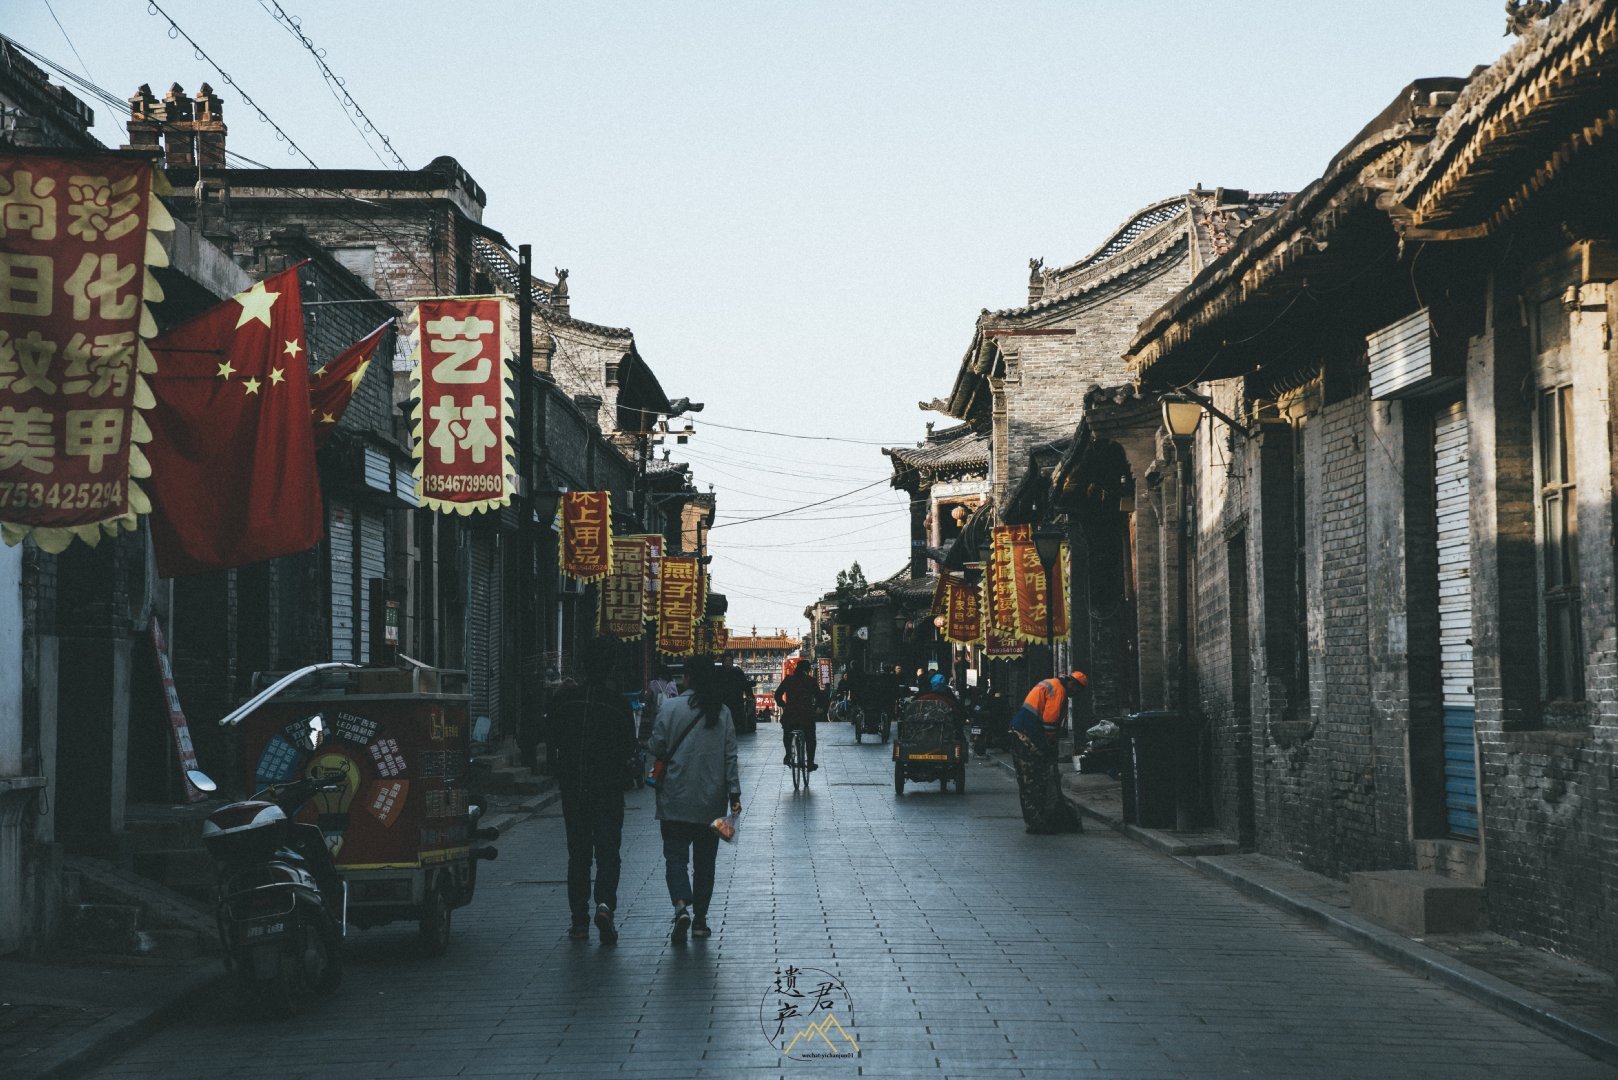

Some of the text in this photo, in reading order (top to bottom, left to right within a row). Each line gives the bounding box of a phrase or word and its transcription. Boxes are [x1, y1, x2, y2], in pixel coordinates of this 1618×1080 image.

[426, 316, 497, 464] 艺林
[425, 474, 501, 493] 13546739960
[661, 561, 693, 637] 燕子老店
